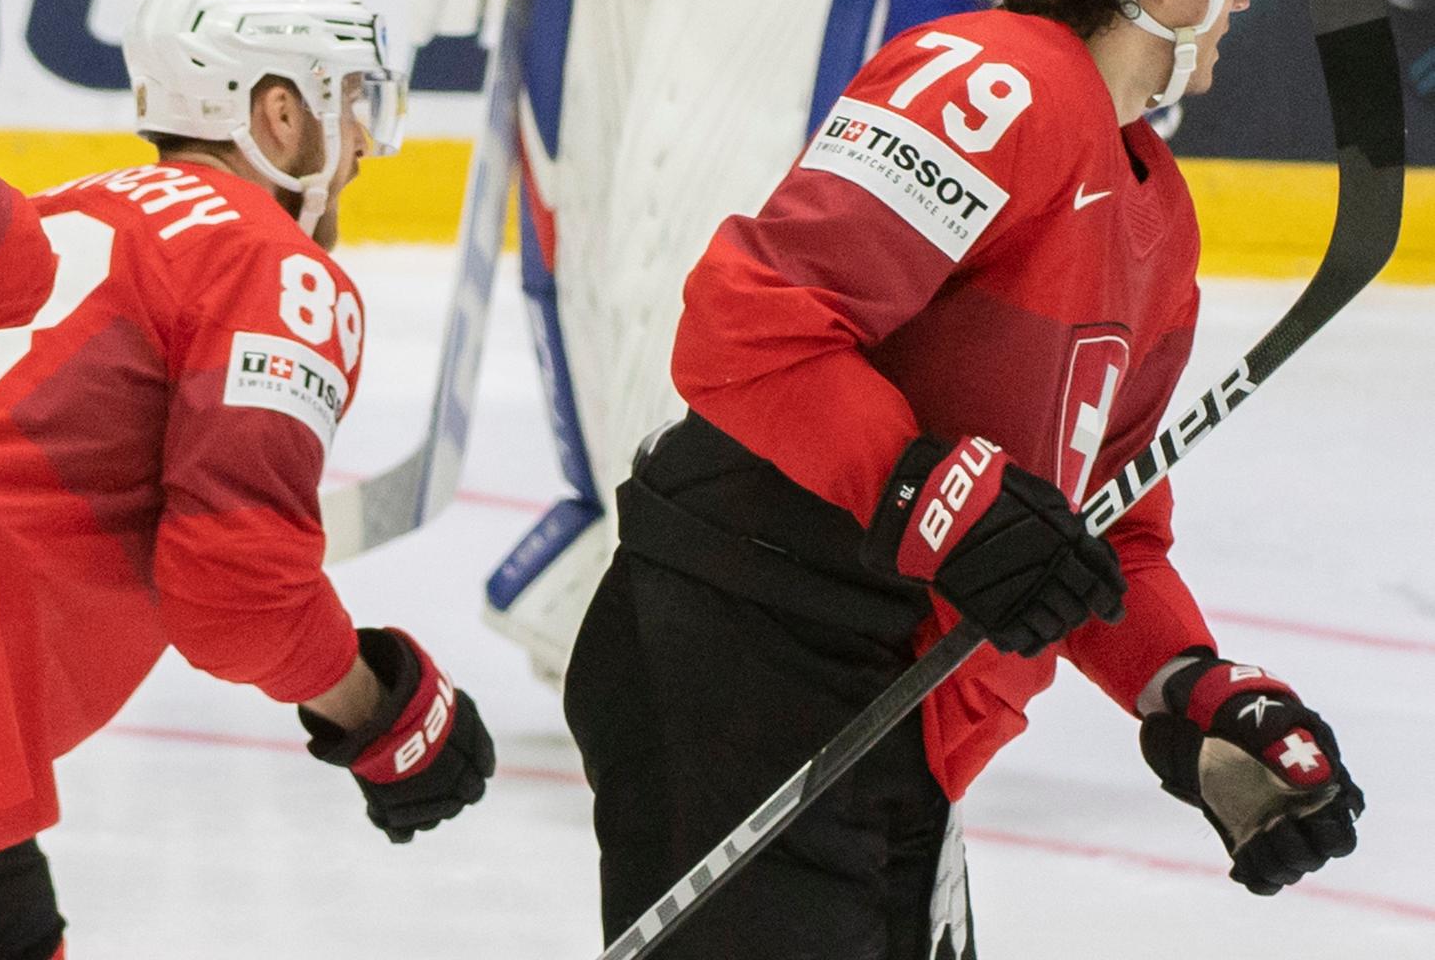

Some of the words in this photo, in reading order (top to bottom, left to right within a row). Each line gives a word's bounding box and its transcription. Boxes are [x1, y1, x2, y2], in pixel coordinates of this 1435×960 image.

[886, 30, 1033, 153] 79
[816, 141, 846, 154] SWISS
[847, 149, 903, 184] WATCHES
[904, 183, 940, 217] SINCE
[941, 215, 969, 240] 1853
[866, 126, 989, 220] TISSOT
[278, 252, 363, 374] 89
